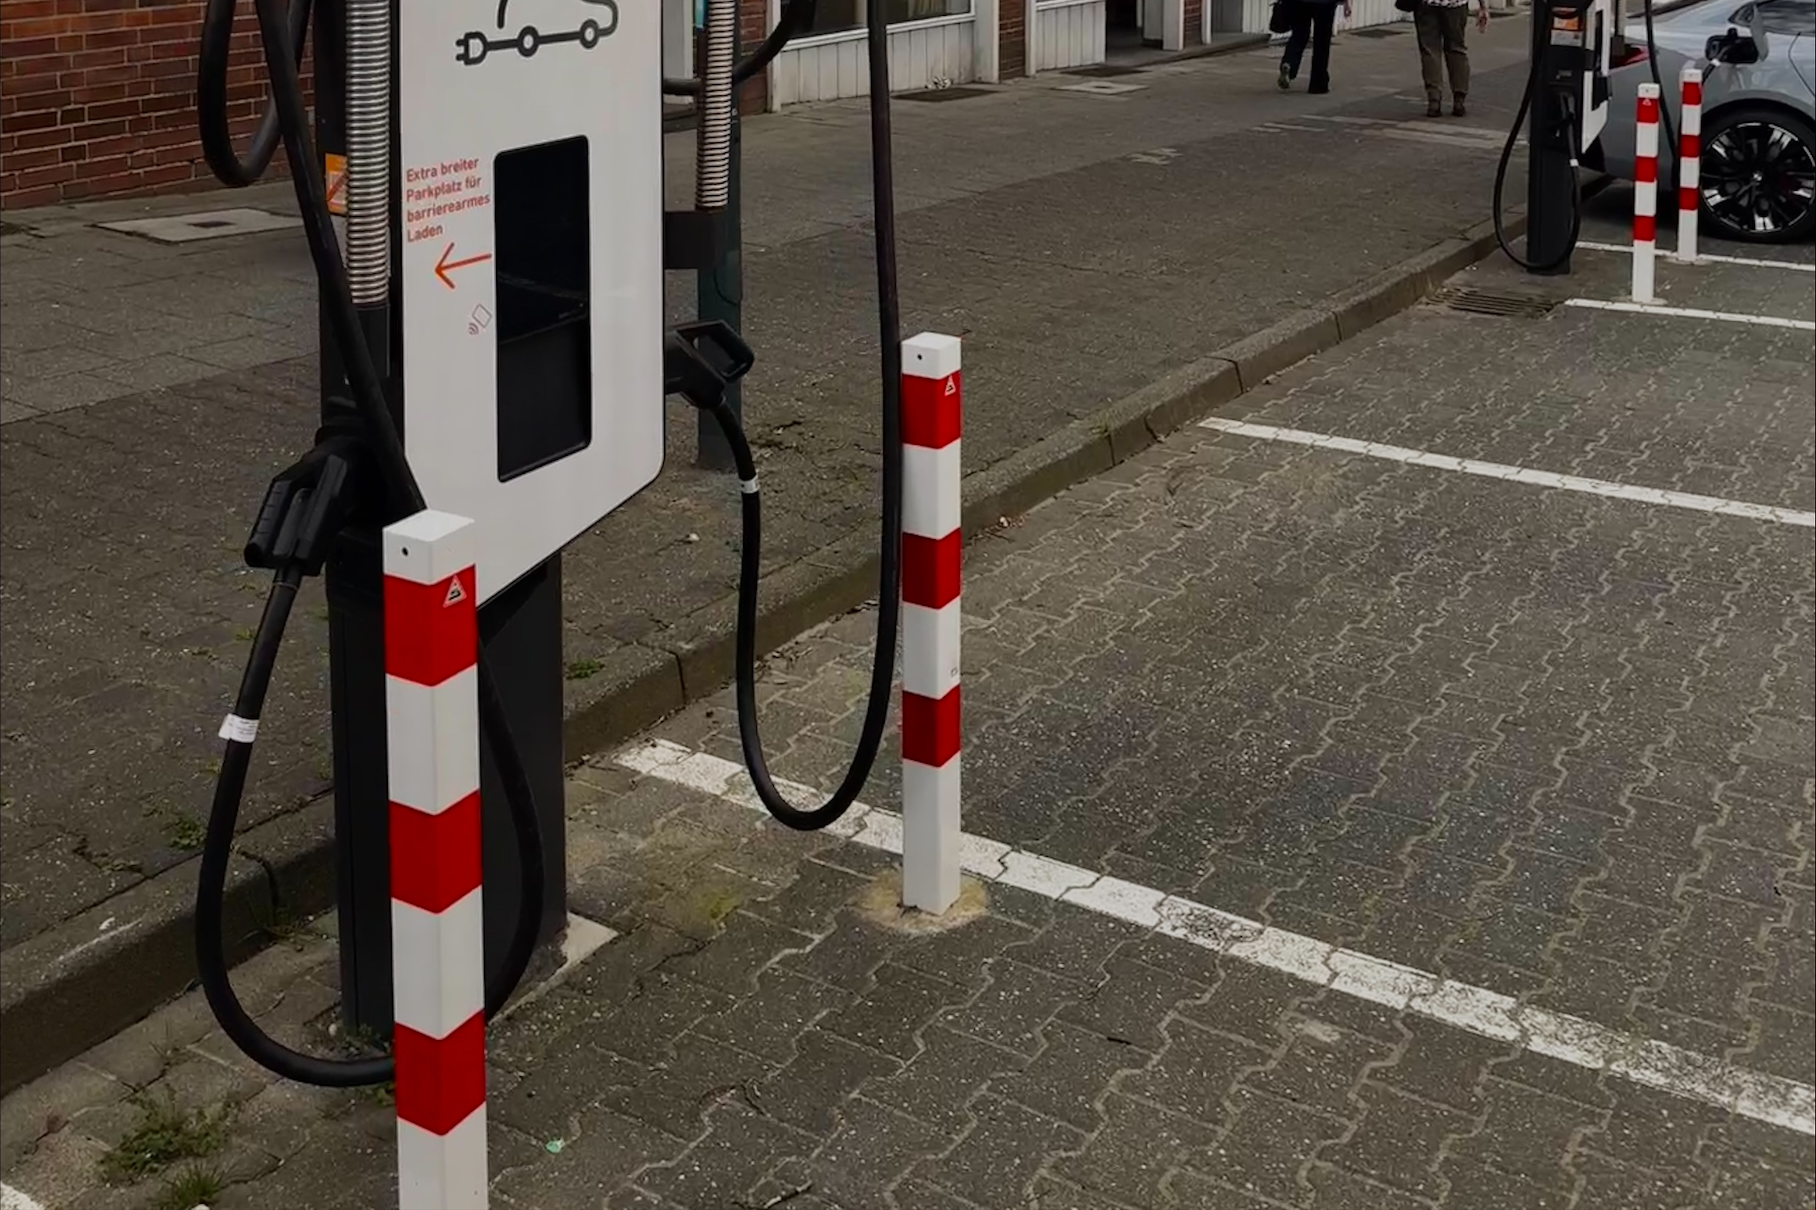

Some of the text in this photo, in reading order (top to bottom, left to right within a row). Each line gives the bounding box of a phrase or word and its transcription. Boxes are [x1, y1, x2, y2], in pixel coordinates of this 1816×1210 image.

[406, 158, 479, 183] Extra breiter
[406, 175, 482, 203] Parkplatz für
[407, 193, 491, 223] barrierearmes
[407, 224, 443, 242] Laden
